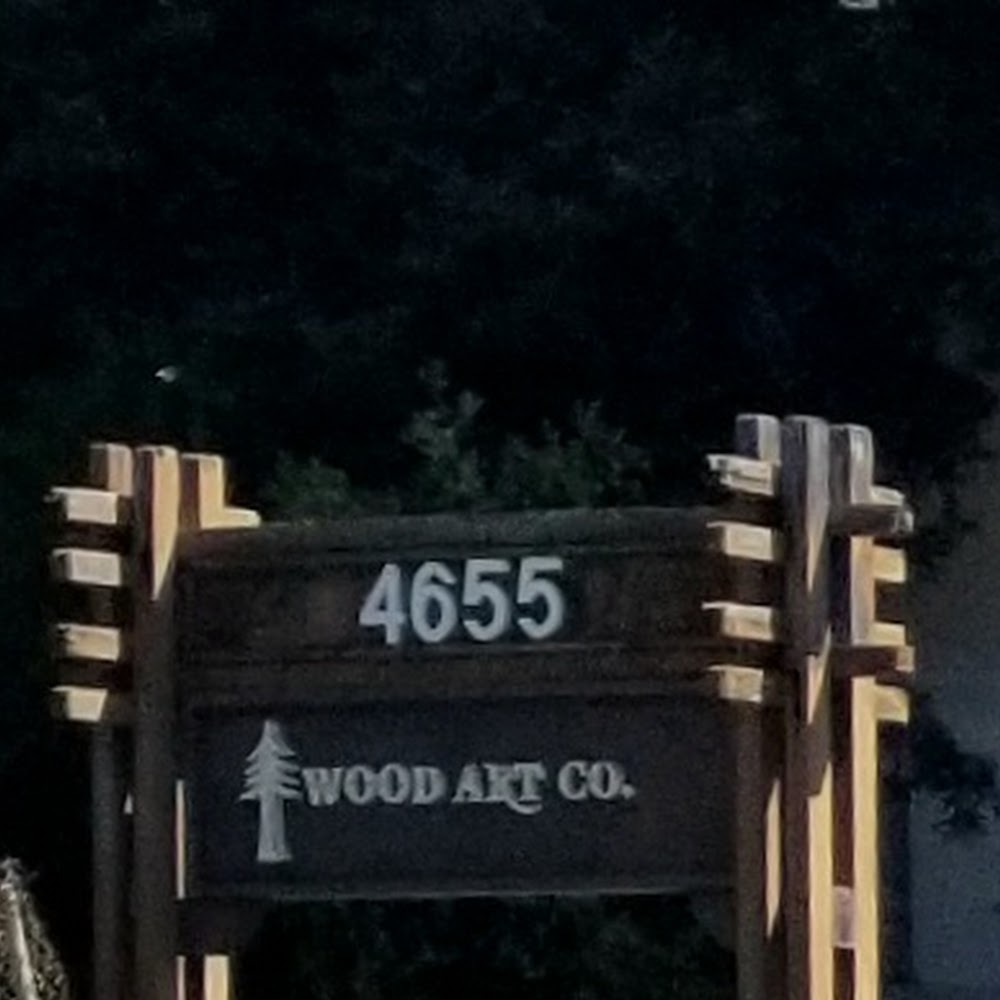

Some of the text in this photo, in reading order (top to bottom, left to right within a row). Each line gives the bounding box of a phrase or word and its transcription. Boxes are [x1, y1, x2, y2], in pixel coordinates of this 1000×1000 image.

[359, 556, 565, 645] 4655
[302, 761, 636, 815] WOOD ART CO.
